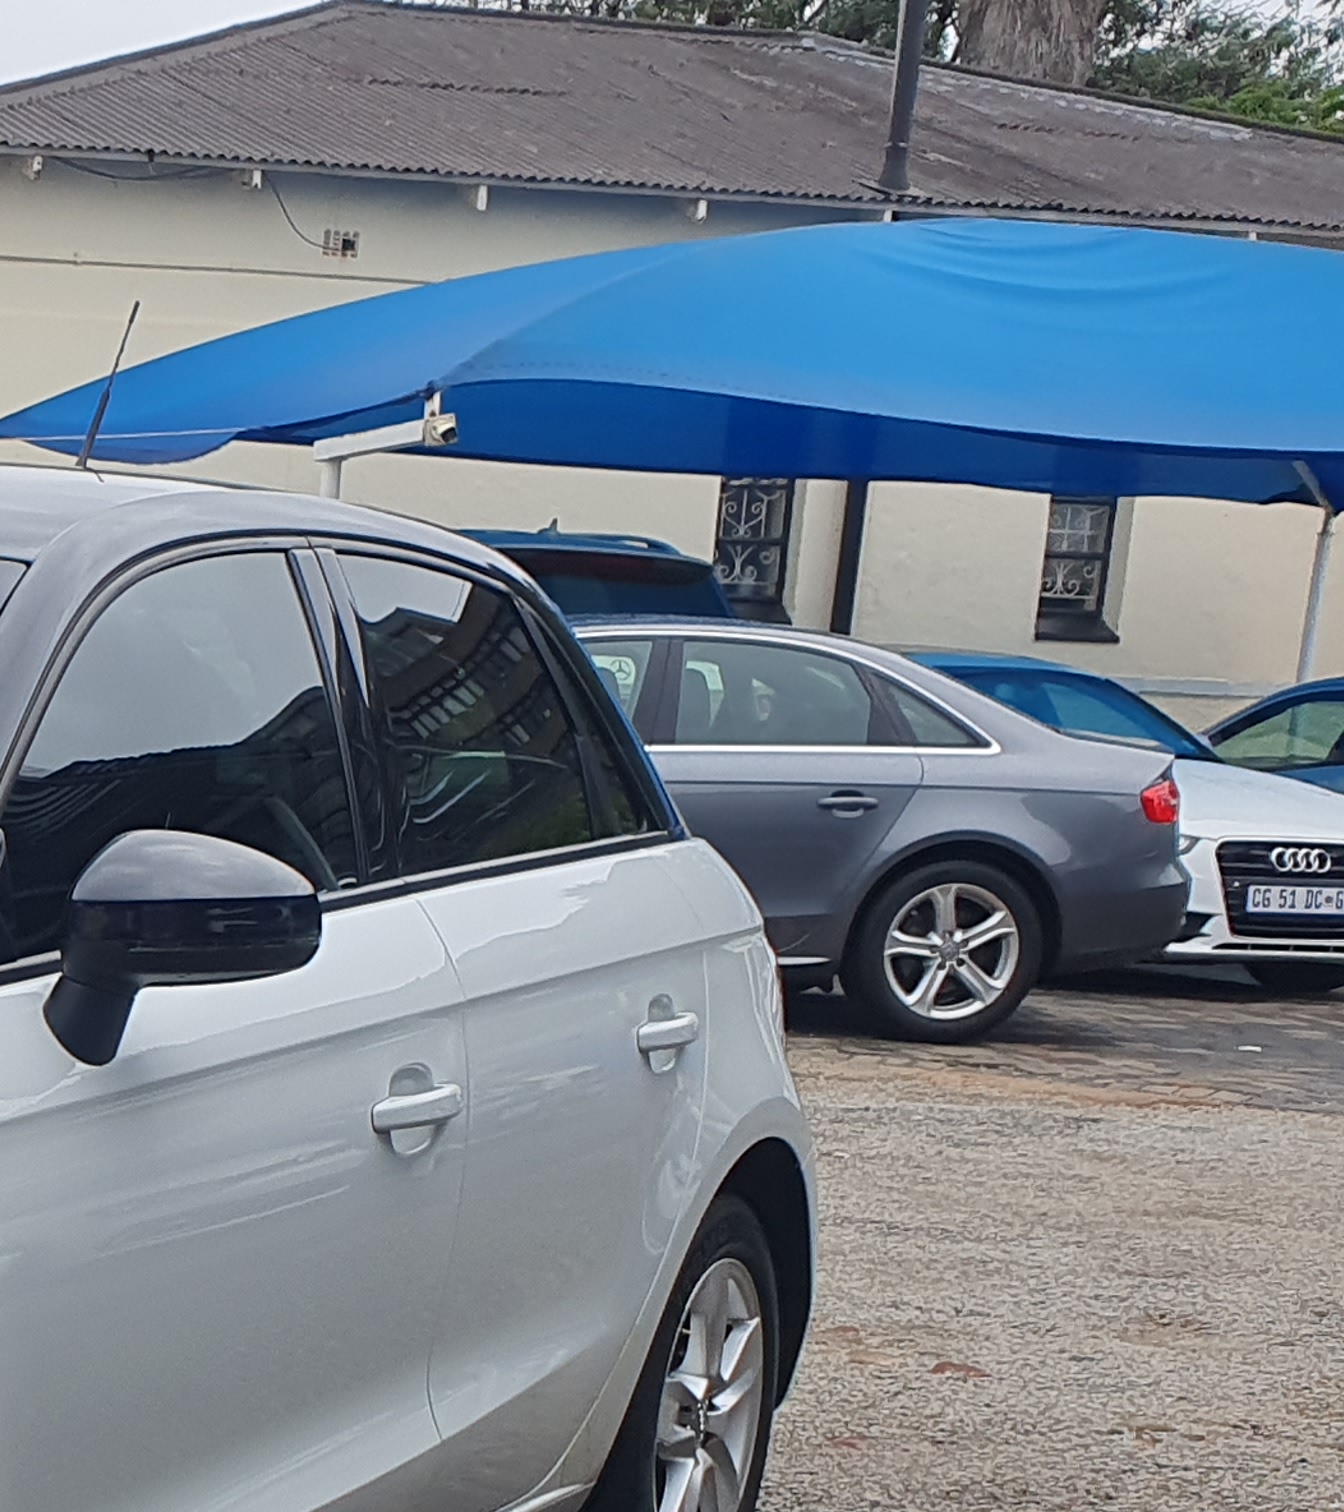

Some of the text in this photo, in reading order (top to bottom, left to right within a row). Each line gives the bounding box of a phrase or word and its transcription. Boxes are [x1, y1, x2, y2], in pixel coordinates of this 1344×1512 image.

[1252, 888, 1272, 909] CG
[1278, 889, 1297, 909] 51
[1304, 889, 1323, 910] DC
